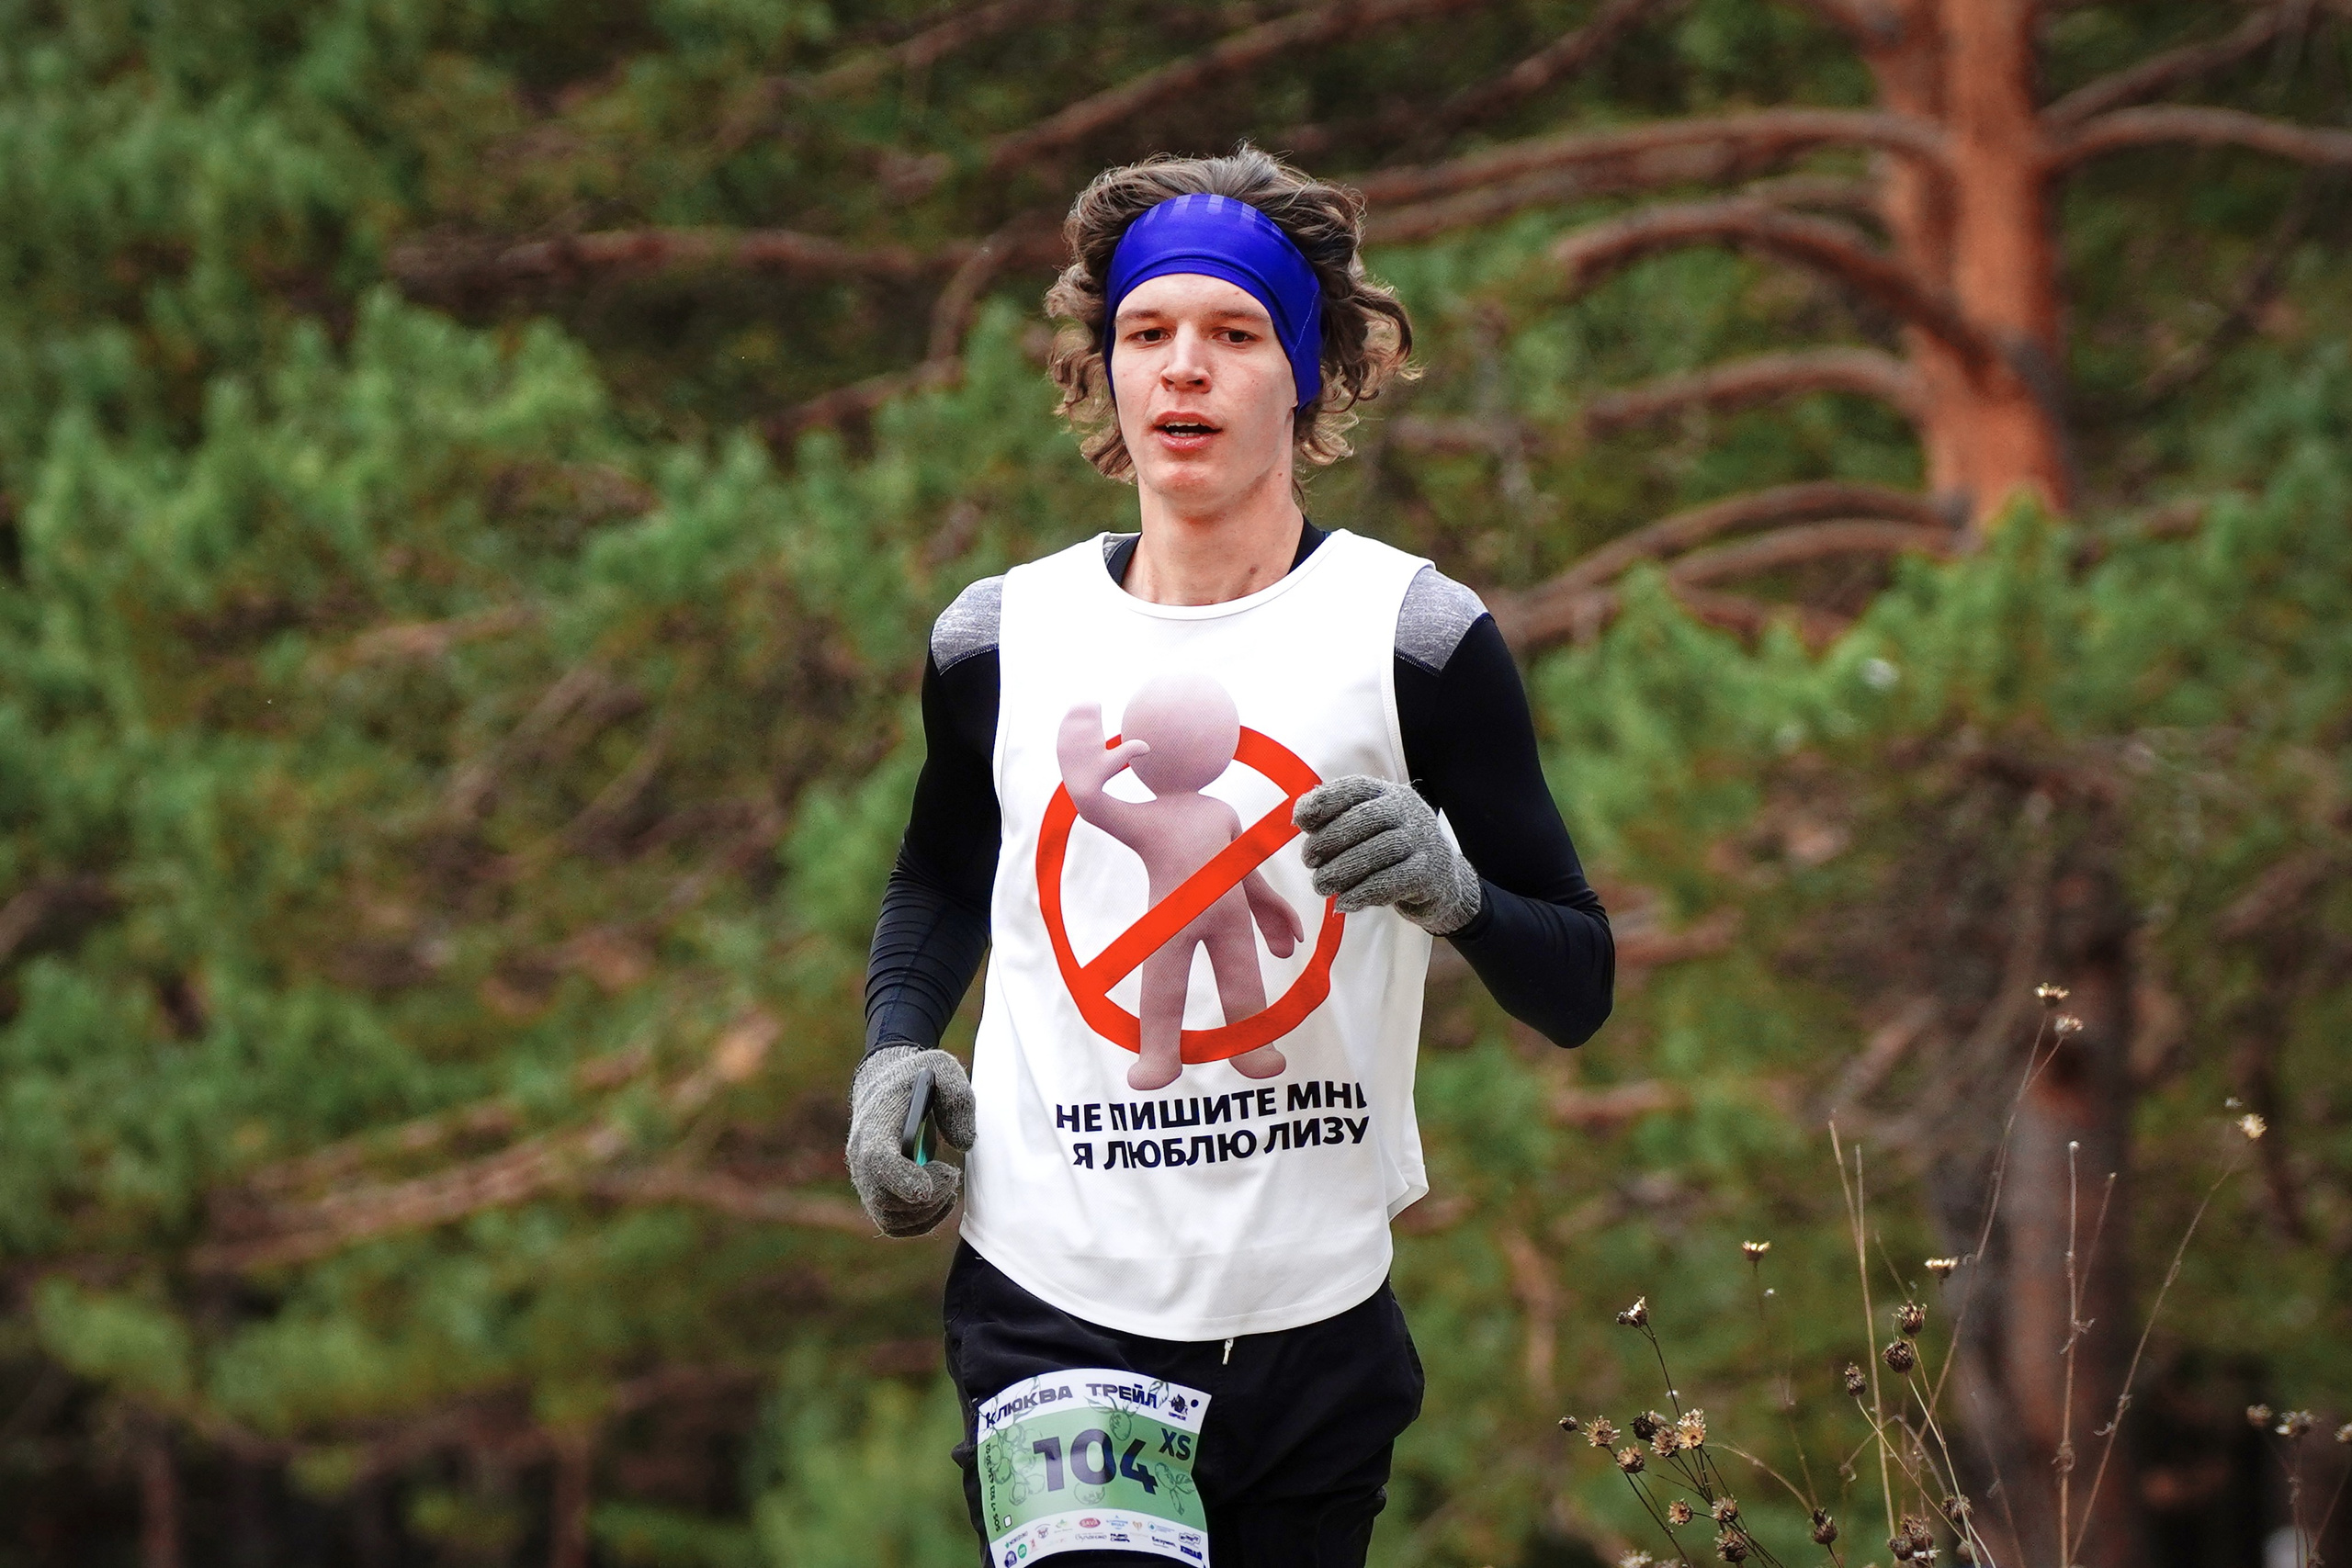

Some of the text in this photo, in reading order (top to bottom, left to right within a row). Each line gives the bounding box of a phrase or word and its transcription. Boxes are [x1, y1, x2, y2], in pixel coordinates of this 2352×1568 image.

[1056, 1103, 1102, 1132] НЕ
[1109, 1087, 1278, 1131] ПИШИТЕ
[1072, 1115, 1370, 1170] Я ЛЮБЛЮ ЛИЗУ
[986, 1382, 1158, 1429] КЛЮКВА ТРЕЙЛ
[1033, 1428, 1159, 1495] 104
[1159, 1427, 1192, 1461] XS
